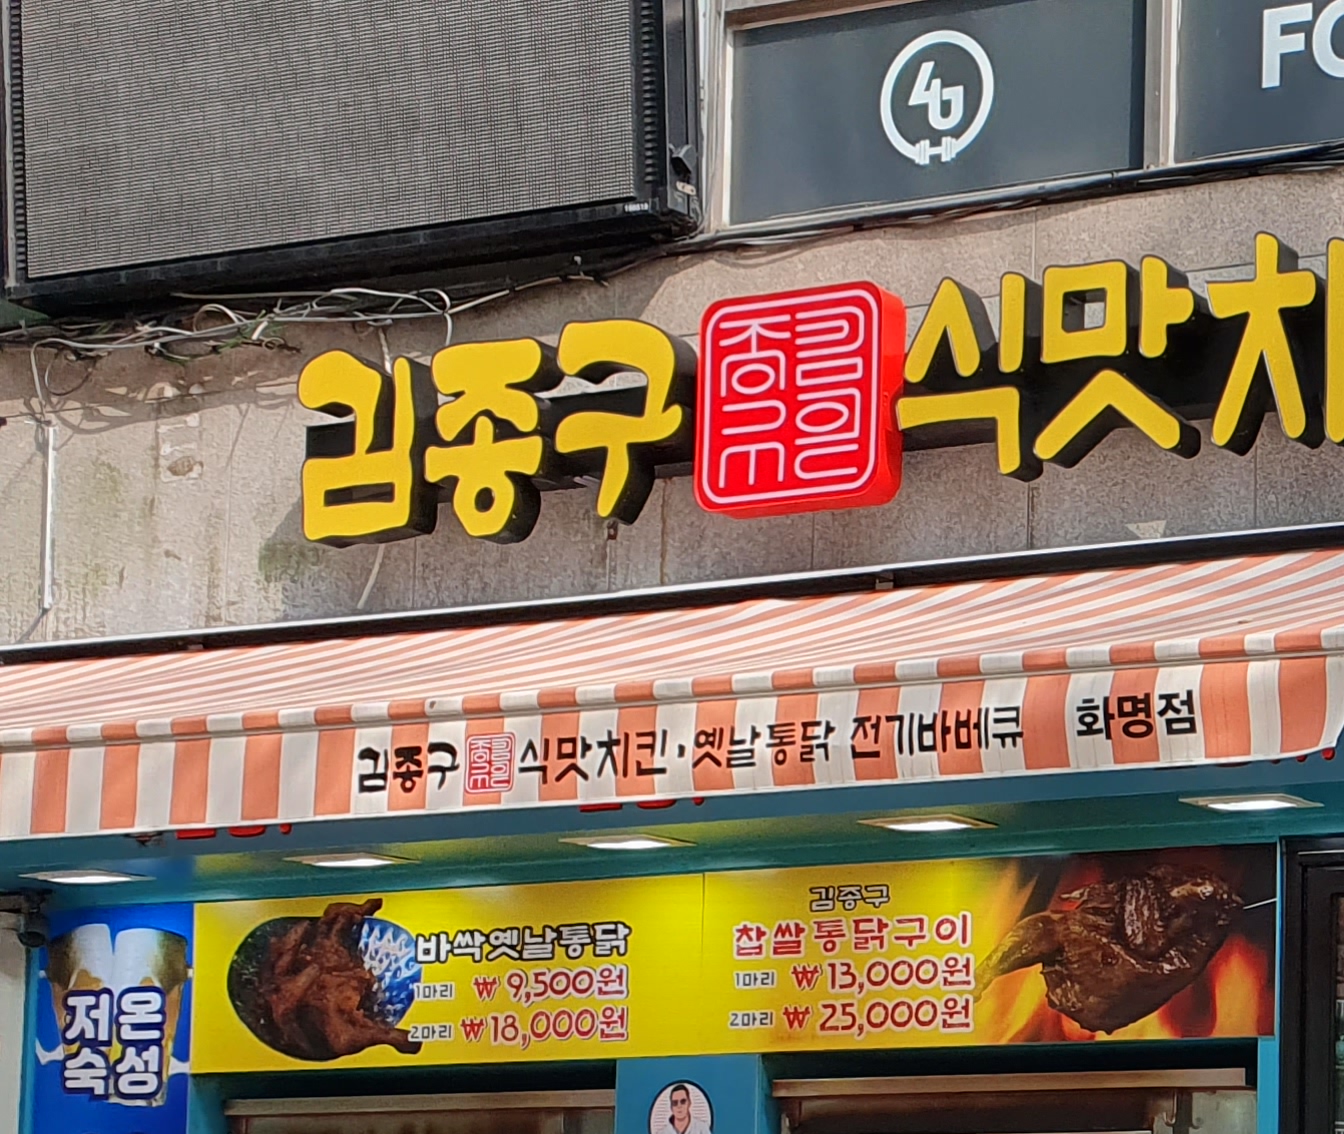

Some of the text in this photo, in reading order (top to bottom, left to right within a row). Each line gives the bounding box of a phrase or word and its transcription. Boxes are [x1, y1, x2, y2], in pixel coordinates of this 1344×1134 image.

[298, 318, 684, 541] 김종구
[356, 741, 460, 794] 김종구
[848, 704, 1024, 760] 전기바베큐
[1075, 689, 1197, 741] 화명점
[808, 884, 892, 913] 김종구
[415, 921, 631, 964] 바싹옛날통닭
[732, 911, 973, 958] 찹쌀통닭구이
[413, 982, 455, 1001] 1마리
[734, 970, 776, 989] 1마리
[66, 990, 164, 1042] 저온
[408, 1025, 453, 1042] 2마리
[729, 1010, 775, 1029] 2마리
[64, 1044, 162, 1095] 숙성
